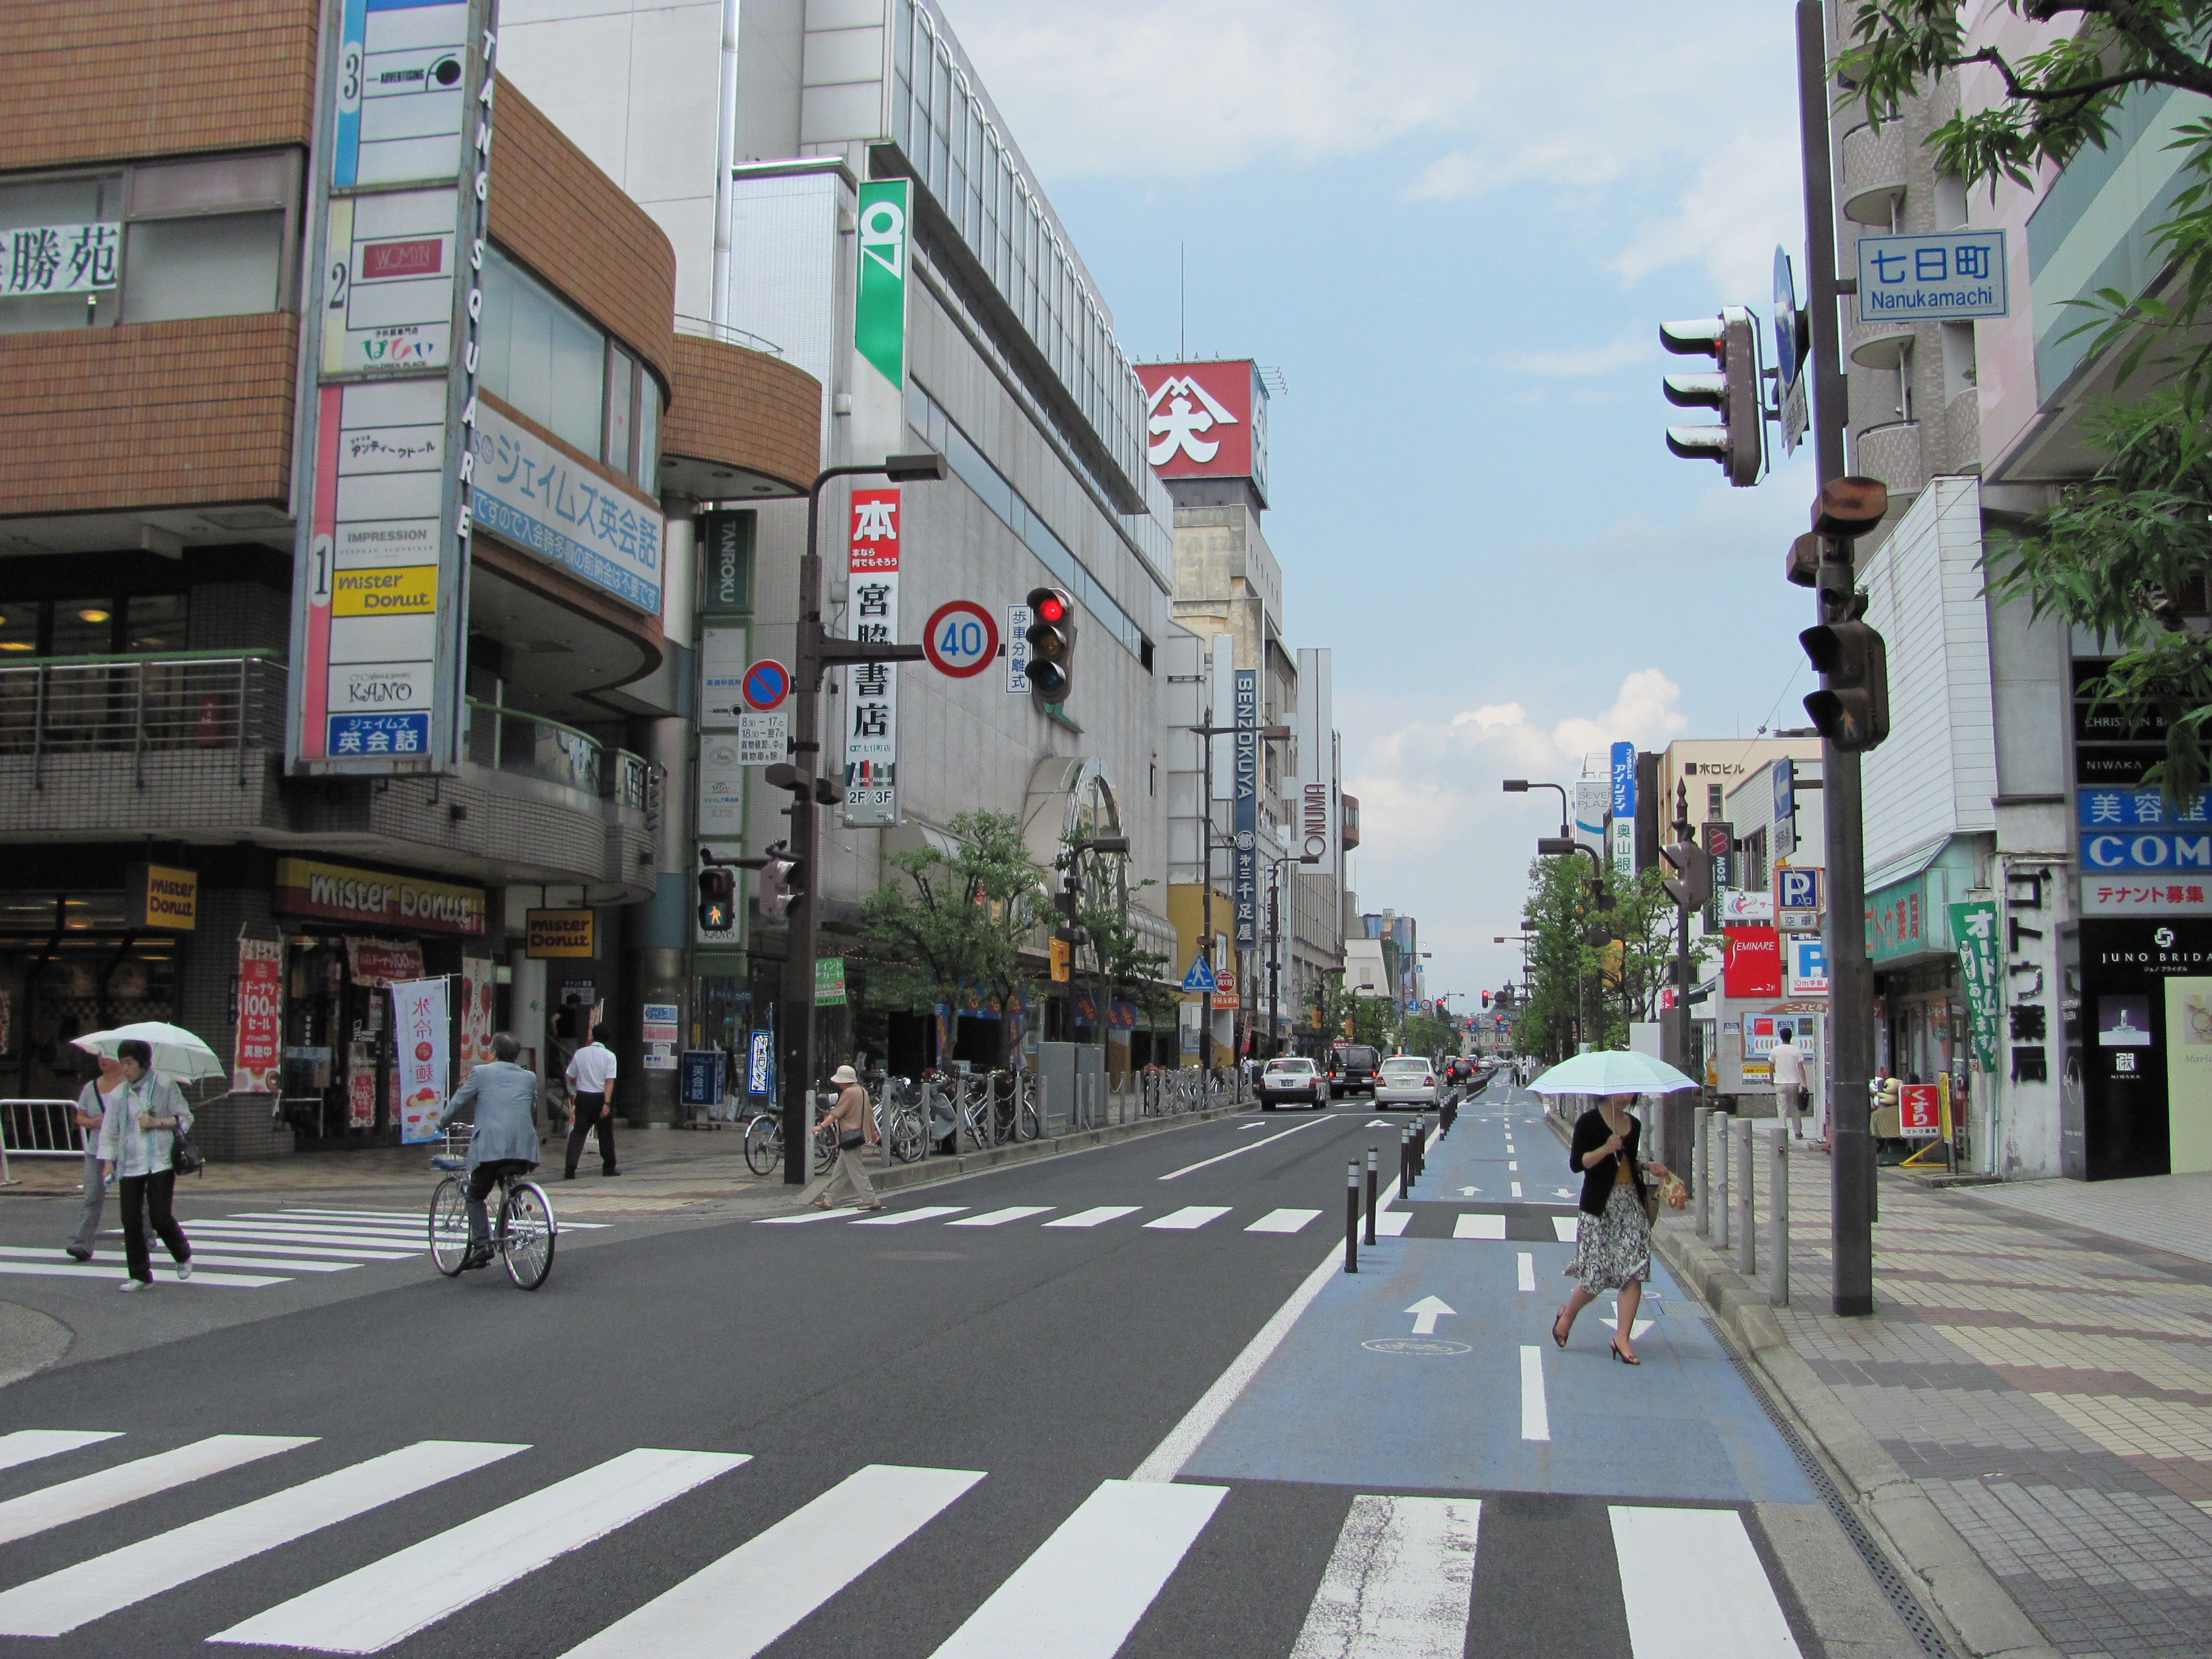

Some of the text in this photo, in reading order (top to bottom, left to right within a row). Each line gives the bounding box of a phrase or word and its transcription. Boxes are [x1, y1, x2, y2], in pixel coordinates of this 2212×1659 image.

[344, 53, 360, 99] 3
[0, 226, 118, 293] 勝苑
[1871, 246, 1991, 284] 七日町
[329, 263, 351, 309] 2
[1871, 286, 1993, 309] Nanukamachi
[455, 238, 485, 538] SQUARE
[496, 434, 658, 570] ジェイムズ英会話
[854, 500, 897, 542] 本
[347, 529, 427, 544] IMPRESSION
[719, 520, 736, 603] TANROKU
[851, 548, 876, 557] 本なら
[851, 558, 898, 568] 何でもそろう
[314, 545, 329, 594] 1
[364, 592, 431, 608] Donut
[940, 622, 981, 656] 40
[1011, 610, 1027, 689] 歩車分離式
[853, 583, 890, 738] 宮脇書店
[348, 682, 412, 702] KANO
[349, 717, 411, 729] ジェイムズ
[338, 730, 418, 753] 英会話
[1237, 677, 1253, 800] SENZOKUYA
[2086, 760, 2142, 769] NIWAKA
[849, 791, 893, 804] 2F/3F
[1613, 764, 1626, 812] アイシティ
[1304, 783, 1327, 855] ONUMA
[2089, 836, 2211, 866] COM
[1716, 856, 1726, 882] MOS
[399, 883, 471, 925] Donut
[1784, 873, 1810, 906] P
[2097, 885, 2204, 903] テナント募集
[150, 896, 193, 917] Donut
[1785, 916, 1811, 927] 空車
[530, 934, 590, 948] Donut
[1729, 939, 1775, 970] SEMINARE
[2102, 953, 2148, 964] JUNO
[246, 980, 275, 995] ドーナツ
[1765, 983, 1775, 991] 2F
[2008, 867, 2053, 1084] ゴトウ薬局
[244, 994, 275, 1017] 100円
[1785, 1003, 1824, 1011] ニーズビル
[1968, 982, 1990, 1050] あります
[248, 1017, 271, 1030] セール
[1911, 1089, 1929, 1126] くすり
